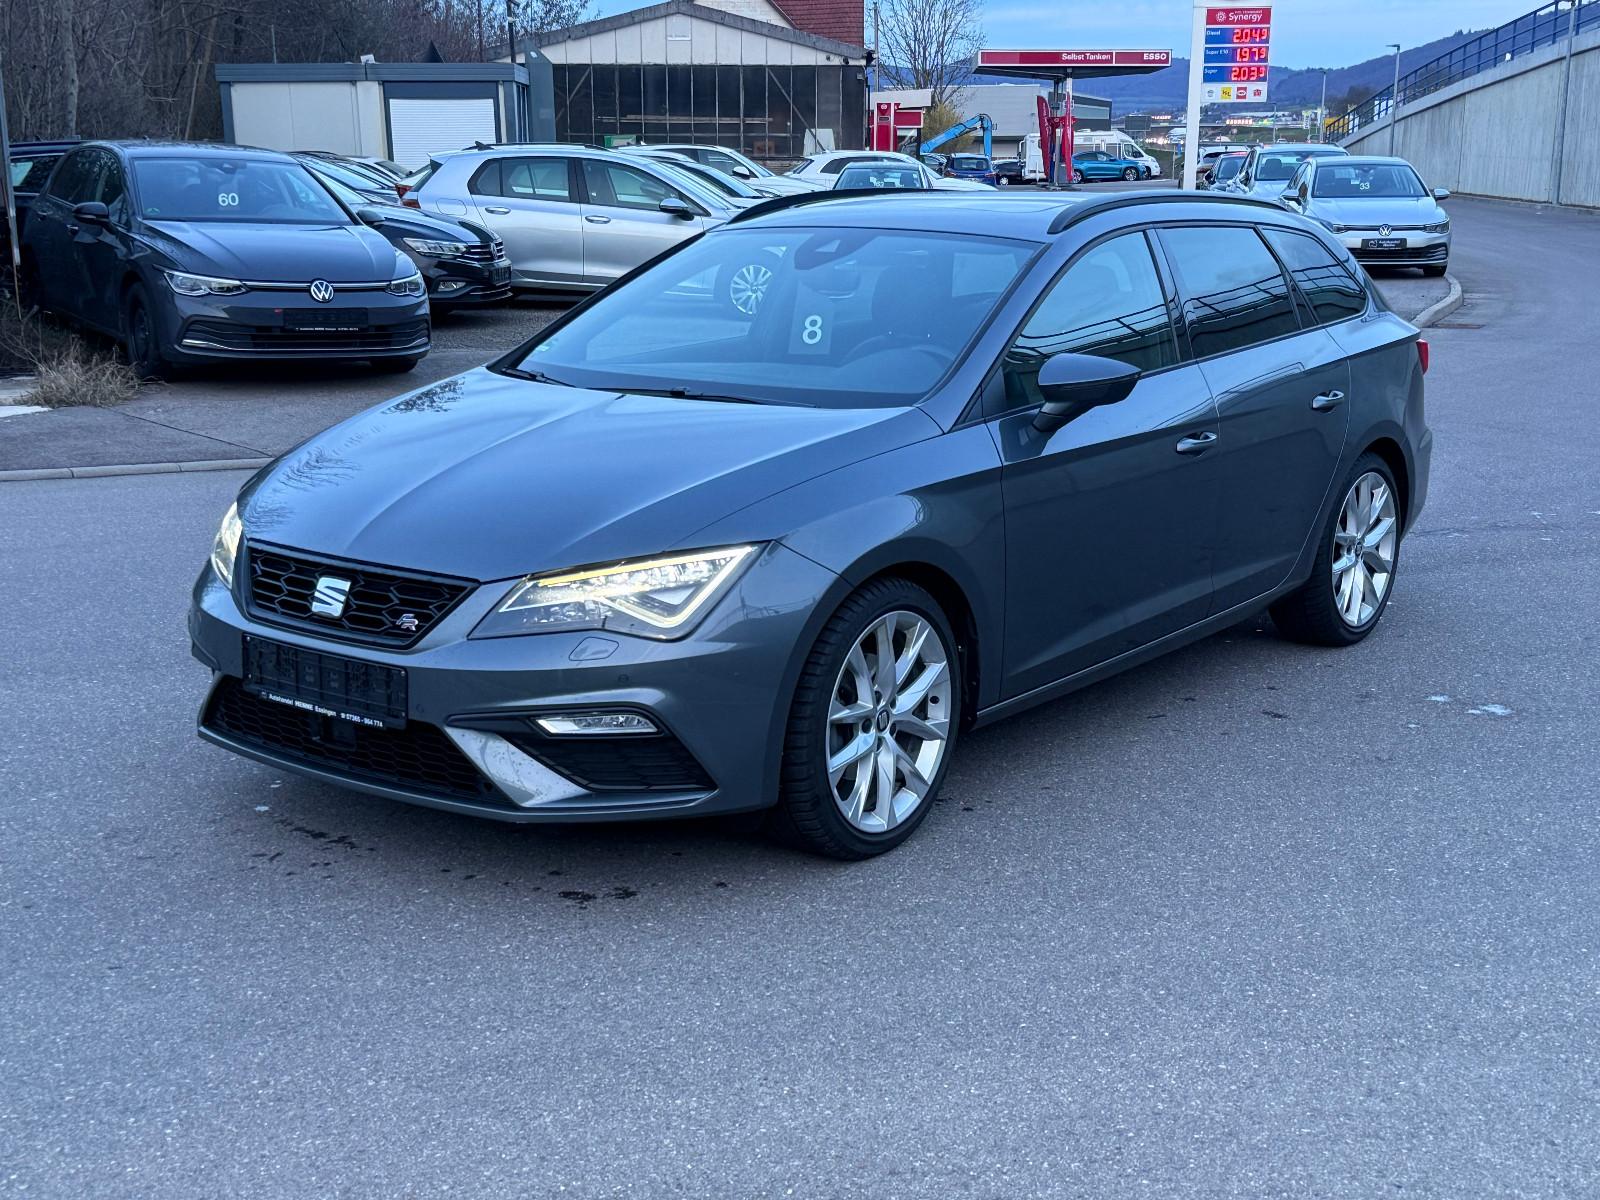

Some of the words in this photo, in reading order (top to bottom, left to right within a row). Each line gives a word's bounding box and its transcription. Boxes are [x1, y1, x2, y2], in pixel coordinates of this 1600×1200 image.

[1228, 13, 1262, 23] Synergy
[1360, 182, 1370, 190] 33
[218, 193, 239, 206] 60
[802, 315, 822, 345] 8
